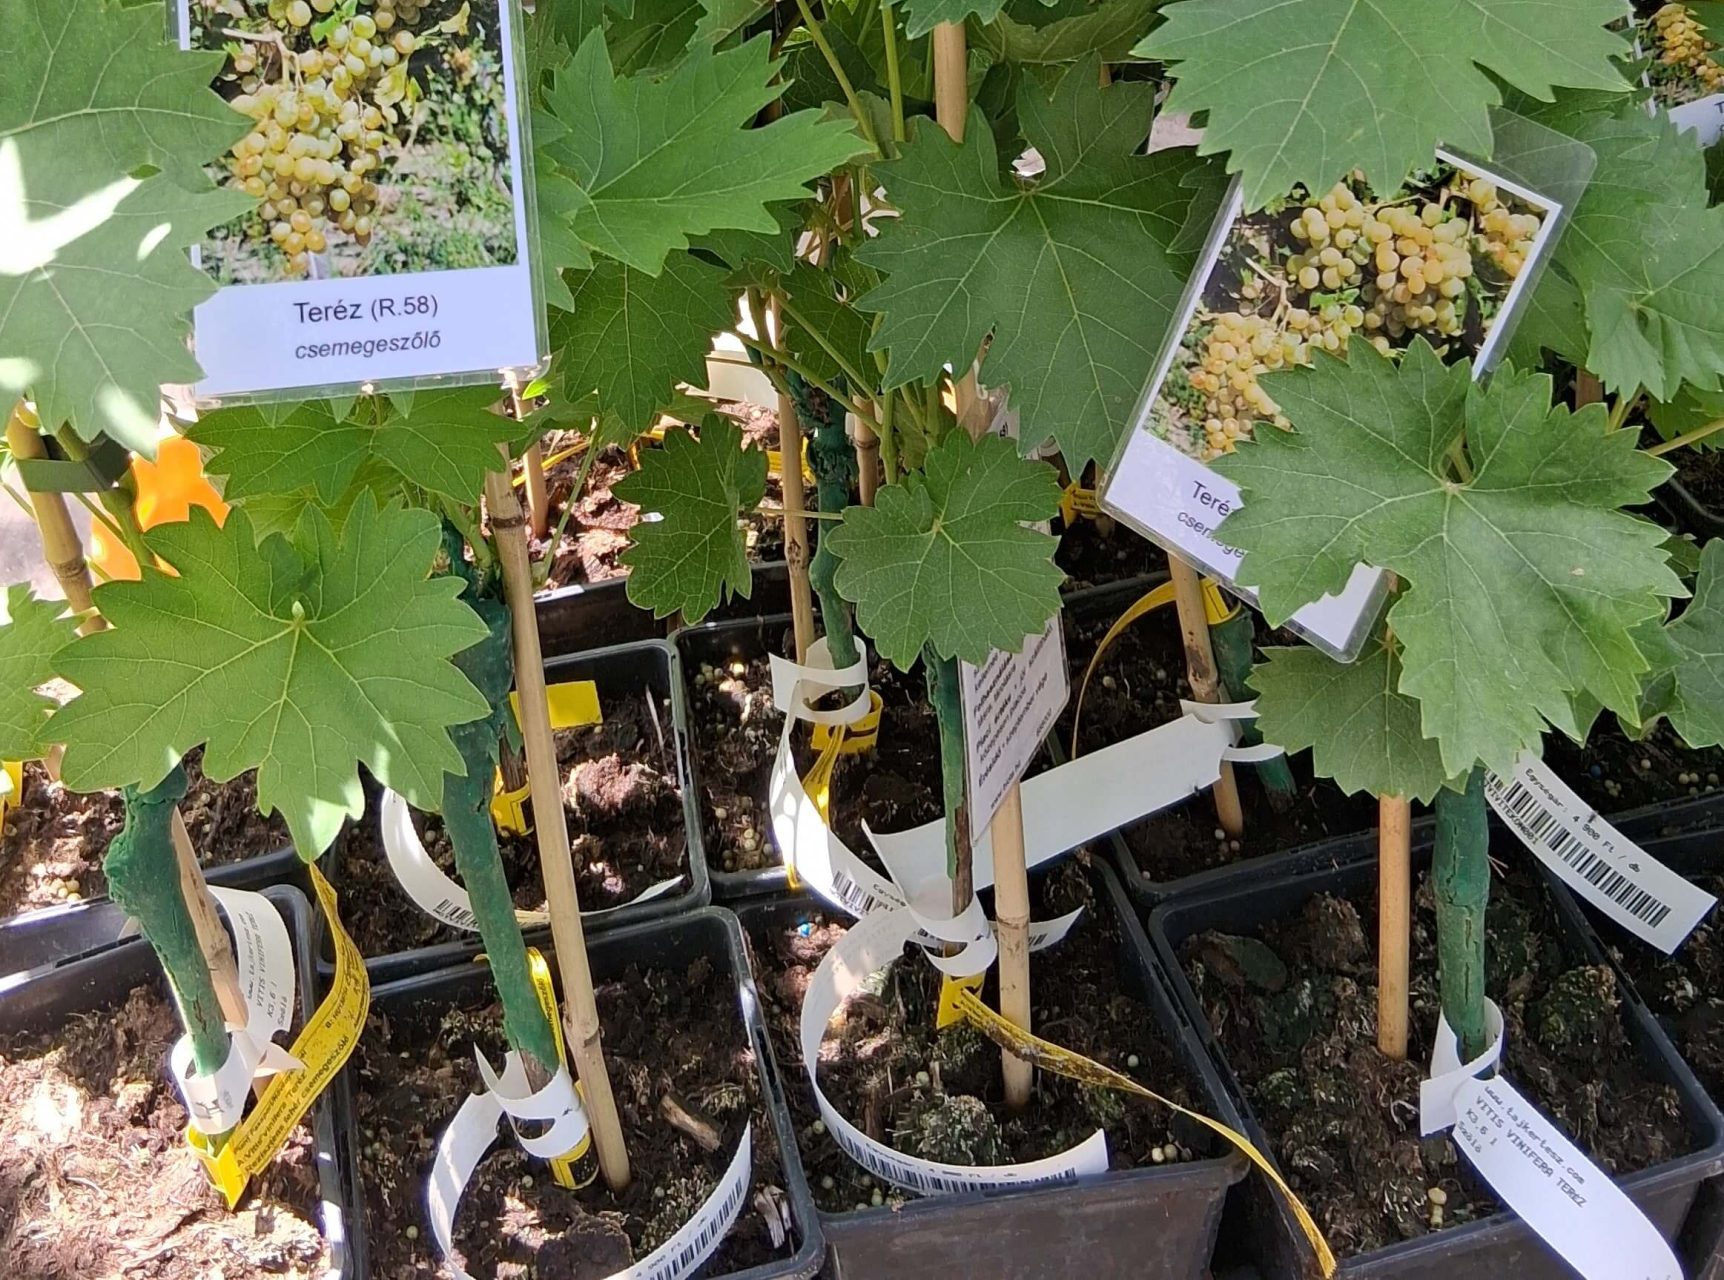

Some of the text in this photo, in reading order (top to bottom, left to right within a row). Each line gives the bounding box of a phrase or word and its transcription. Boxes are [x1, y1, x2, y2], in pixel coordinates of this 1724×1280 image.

[294, 295, 439, 323] Teréz (R.58)
[295, 331, 441, 360] csemegeszőlő
[1193, 480, 1232, 516] Teré
[1582, 823, 1601, 840] 900
[257, 977, 266, 1006] VITIS
[1476, 1096, 1503, 1129] VITIS
[1506, 1130, 1554, 1178] VINIFERA
